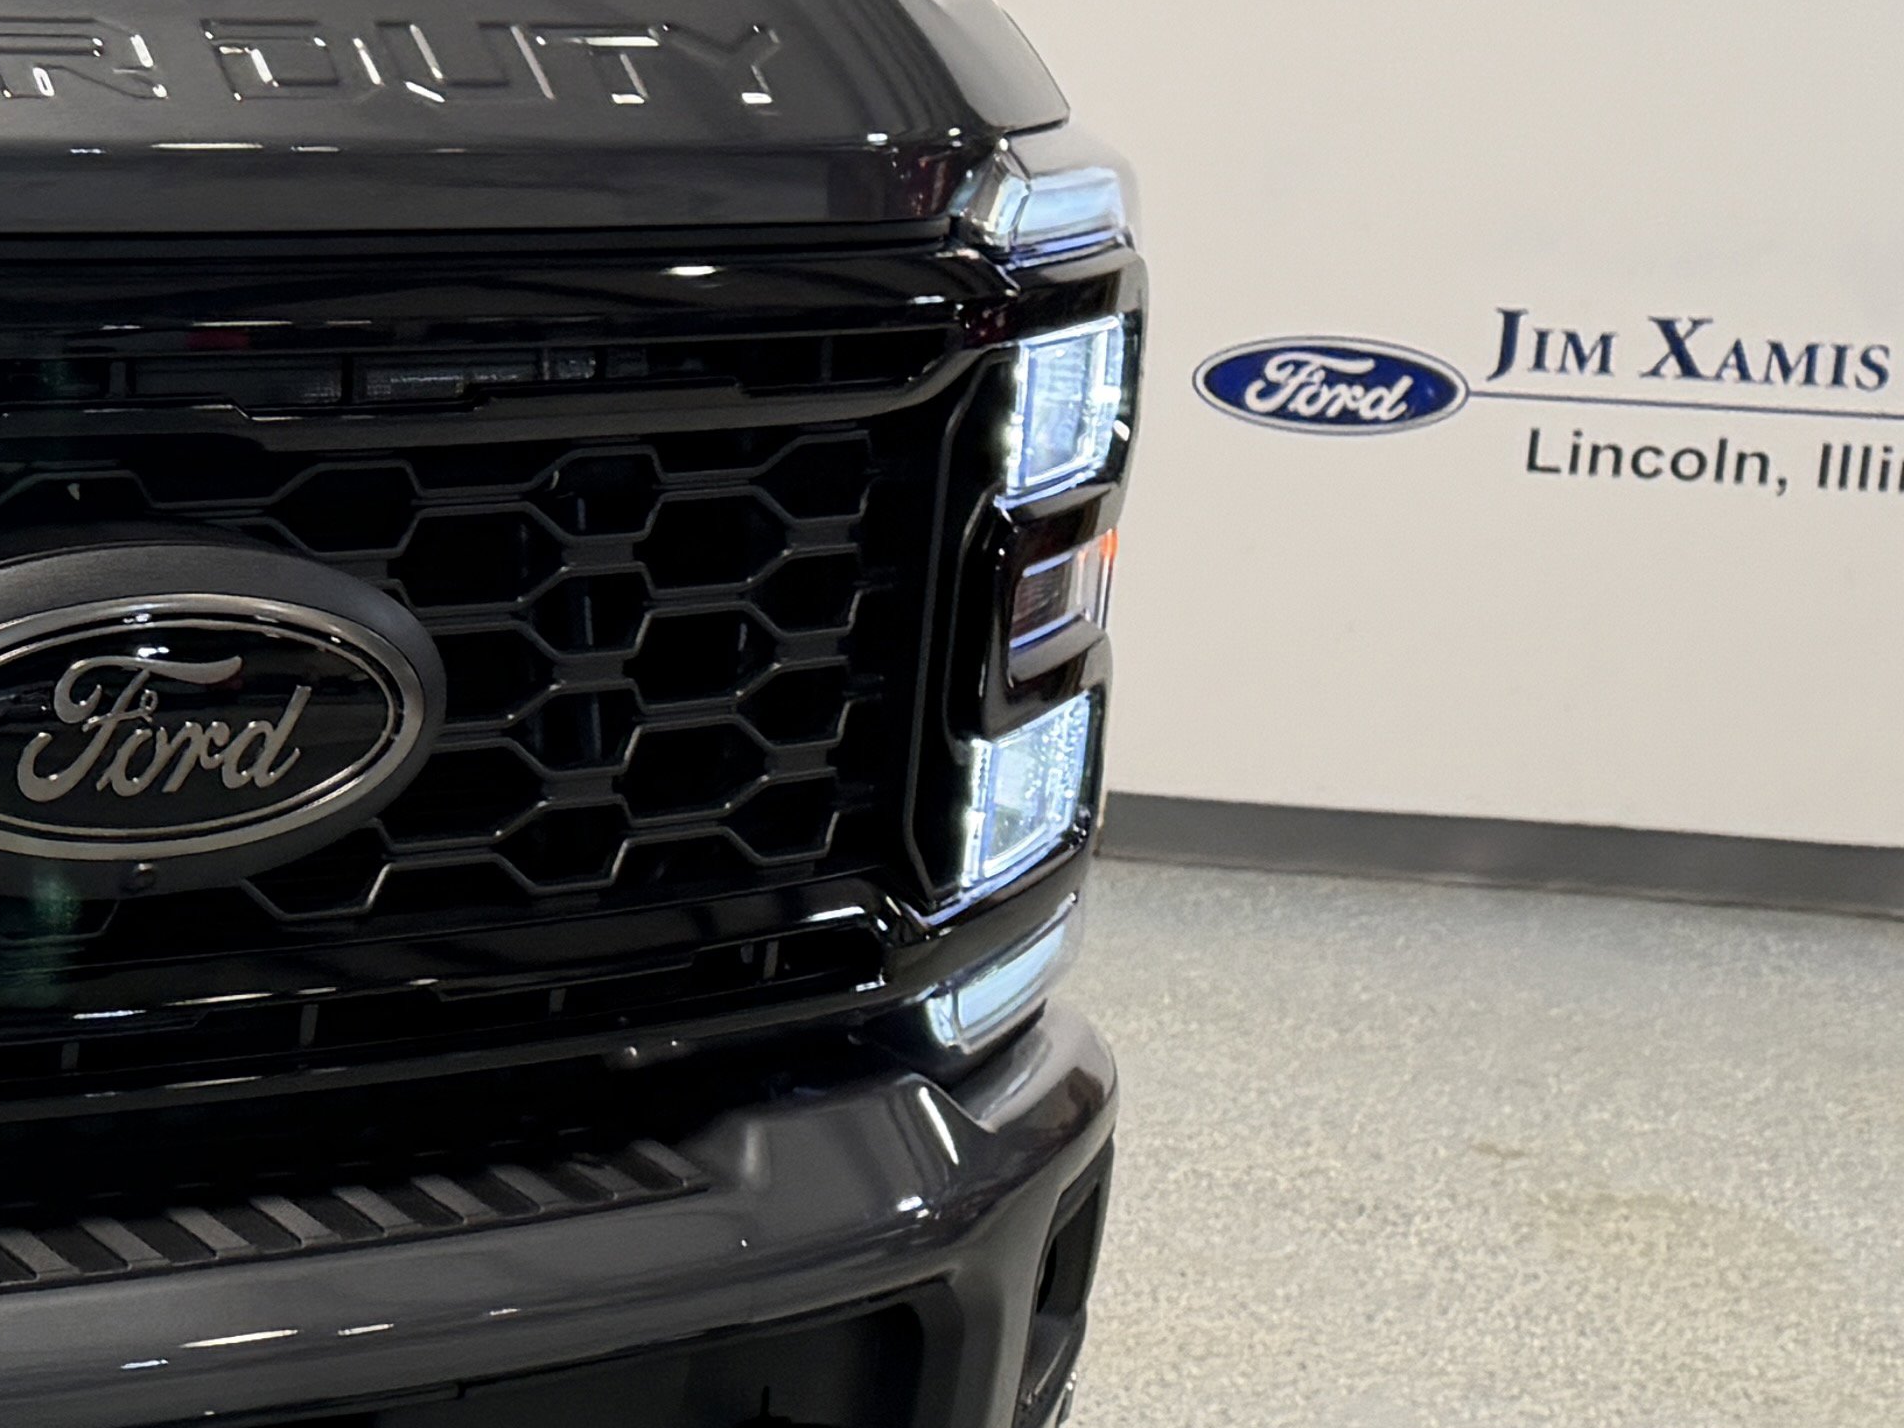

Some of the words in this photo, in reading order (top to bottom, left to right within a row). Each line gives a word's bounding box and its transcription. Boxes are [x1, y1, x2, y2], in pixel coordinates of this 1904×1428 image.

[198, 16, 780, 106] DUTY
[1244, 351, 1410, 422] Ford
[1486, 308, 1618, 382] JIM
[1639, 315, 1891, 392] XAMIS
[1525, 427, 1788, 495] Lincoln,
[1817, 442, 1904, 493] Illi
[16, 655, 312, 803] Ford
